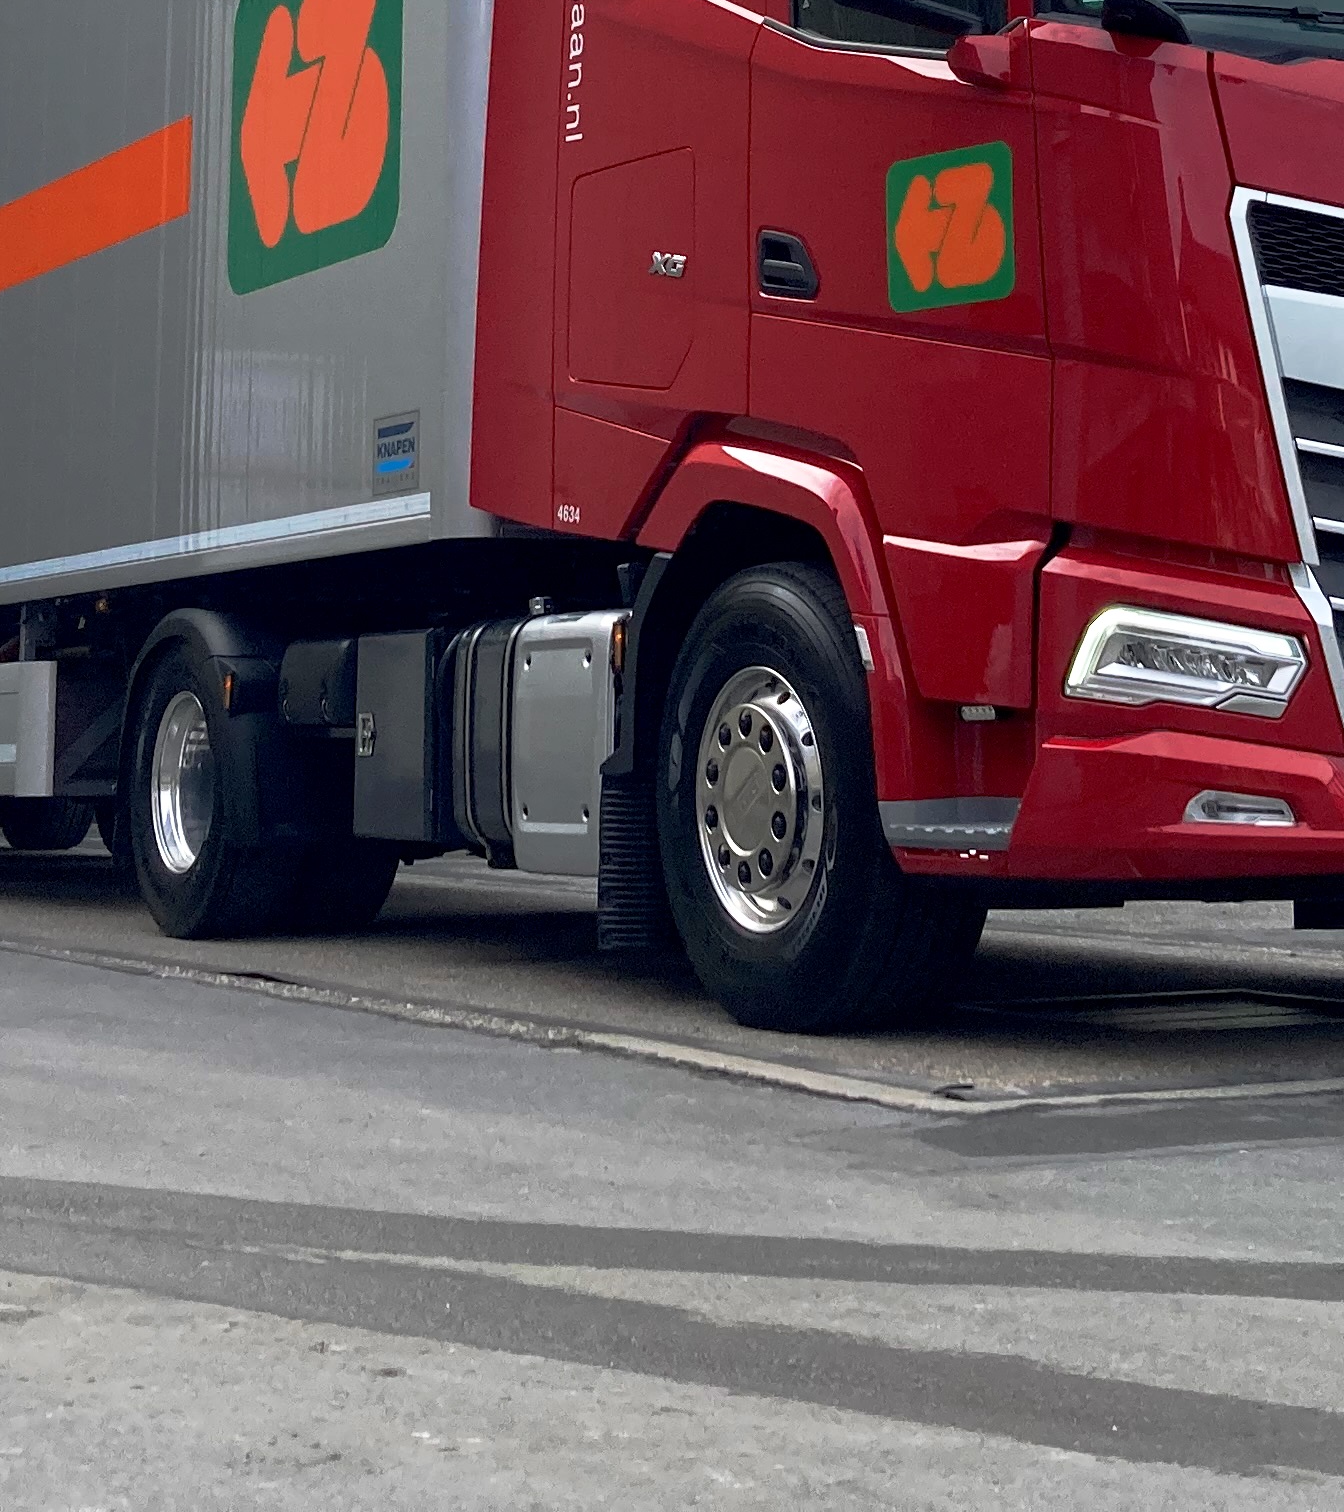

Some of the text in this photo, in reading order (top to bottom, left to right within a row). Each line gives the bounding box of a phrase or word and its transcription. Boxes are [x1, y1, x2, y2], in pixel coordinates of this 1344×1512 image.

[648, 251, 687, 278] XG
[376, 437, 416, 460] KNAPEN
[557, 504, 581, 525] 4634
